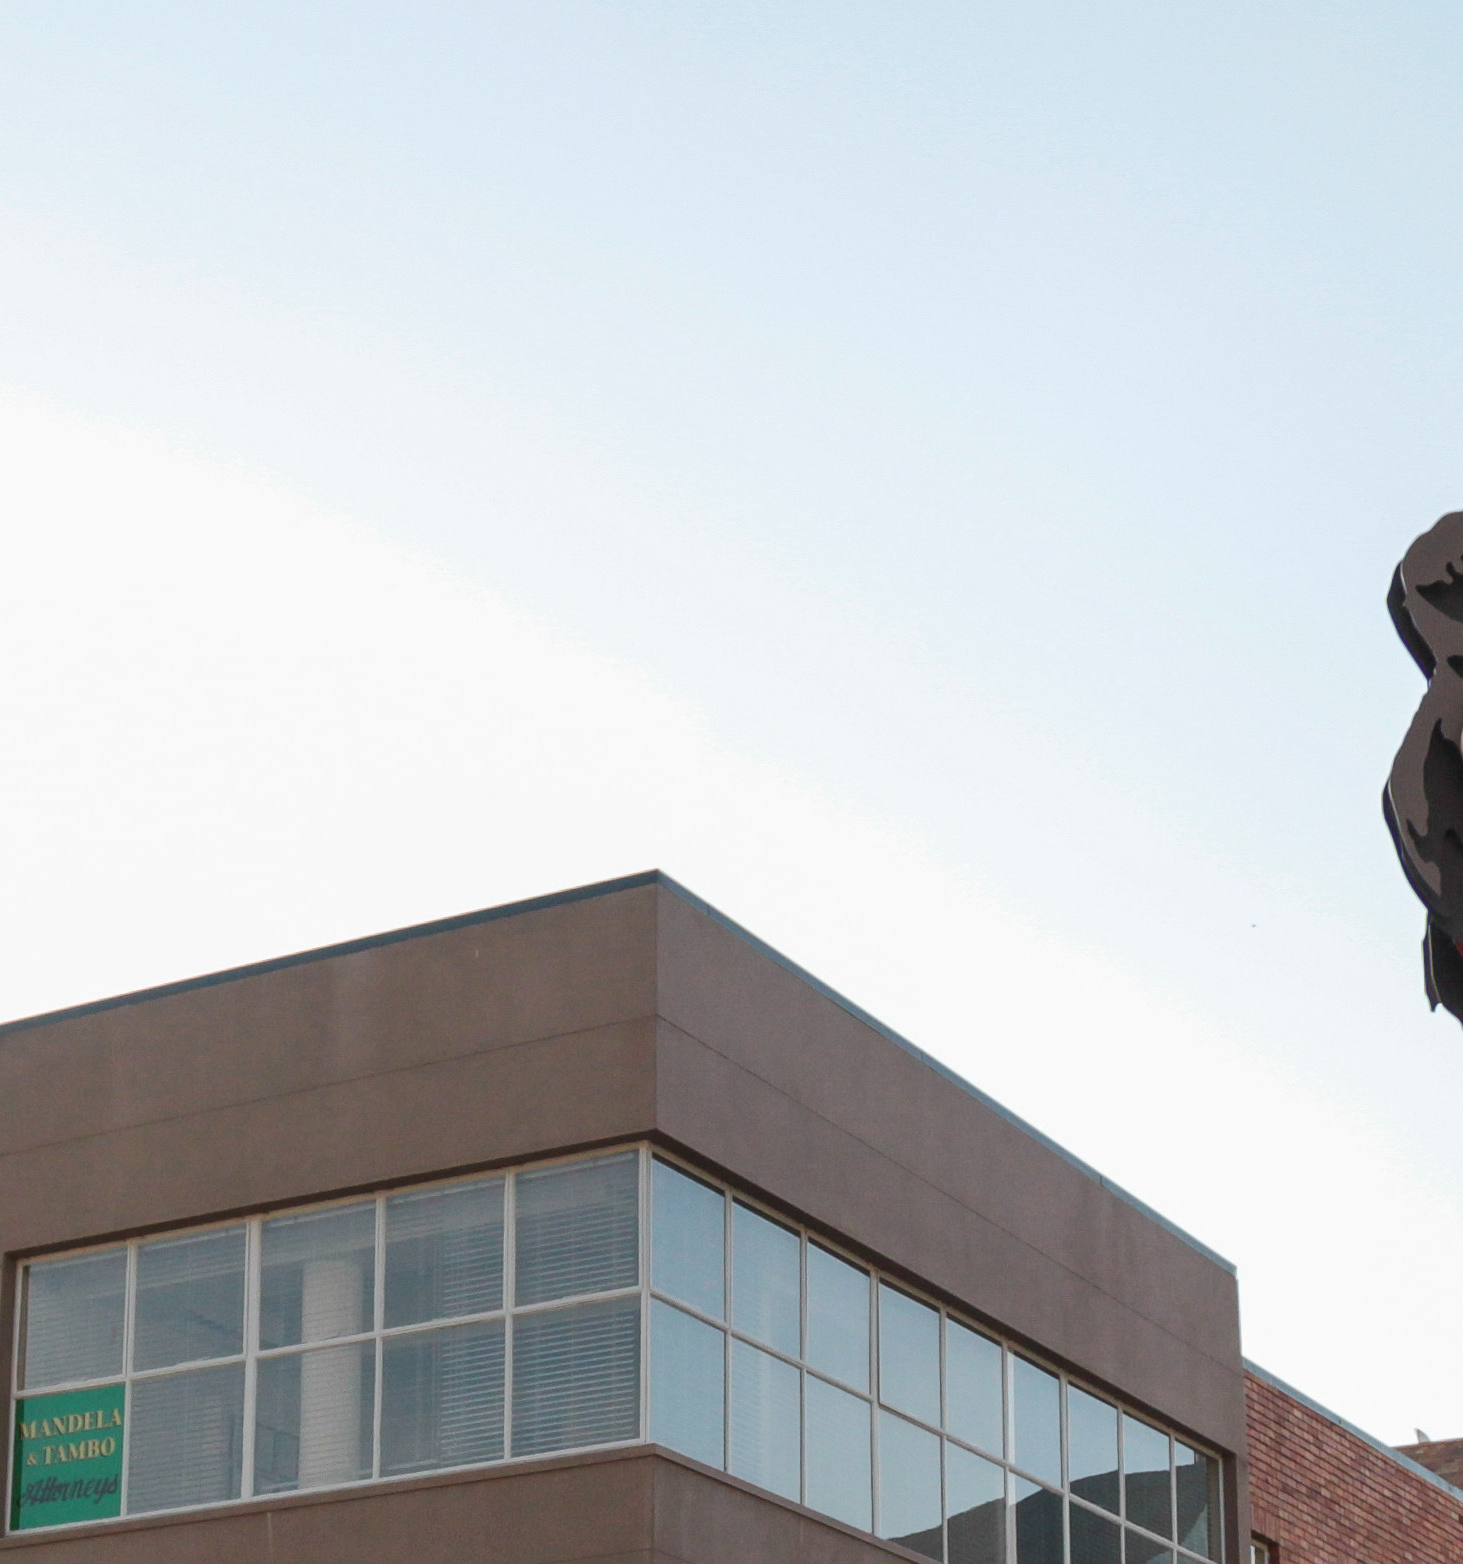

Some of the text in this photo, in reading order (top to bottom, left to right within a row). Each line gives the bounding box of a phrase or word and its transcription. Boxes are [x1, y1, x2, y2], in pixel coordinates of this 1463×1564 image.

[19, 1408, 123, 1441] MANDELA
[25, 1436, 116, 1467] & TAMBO
[17, 1473, 119, 1508] Attorneys
